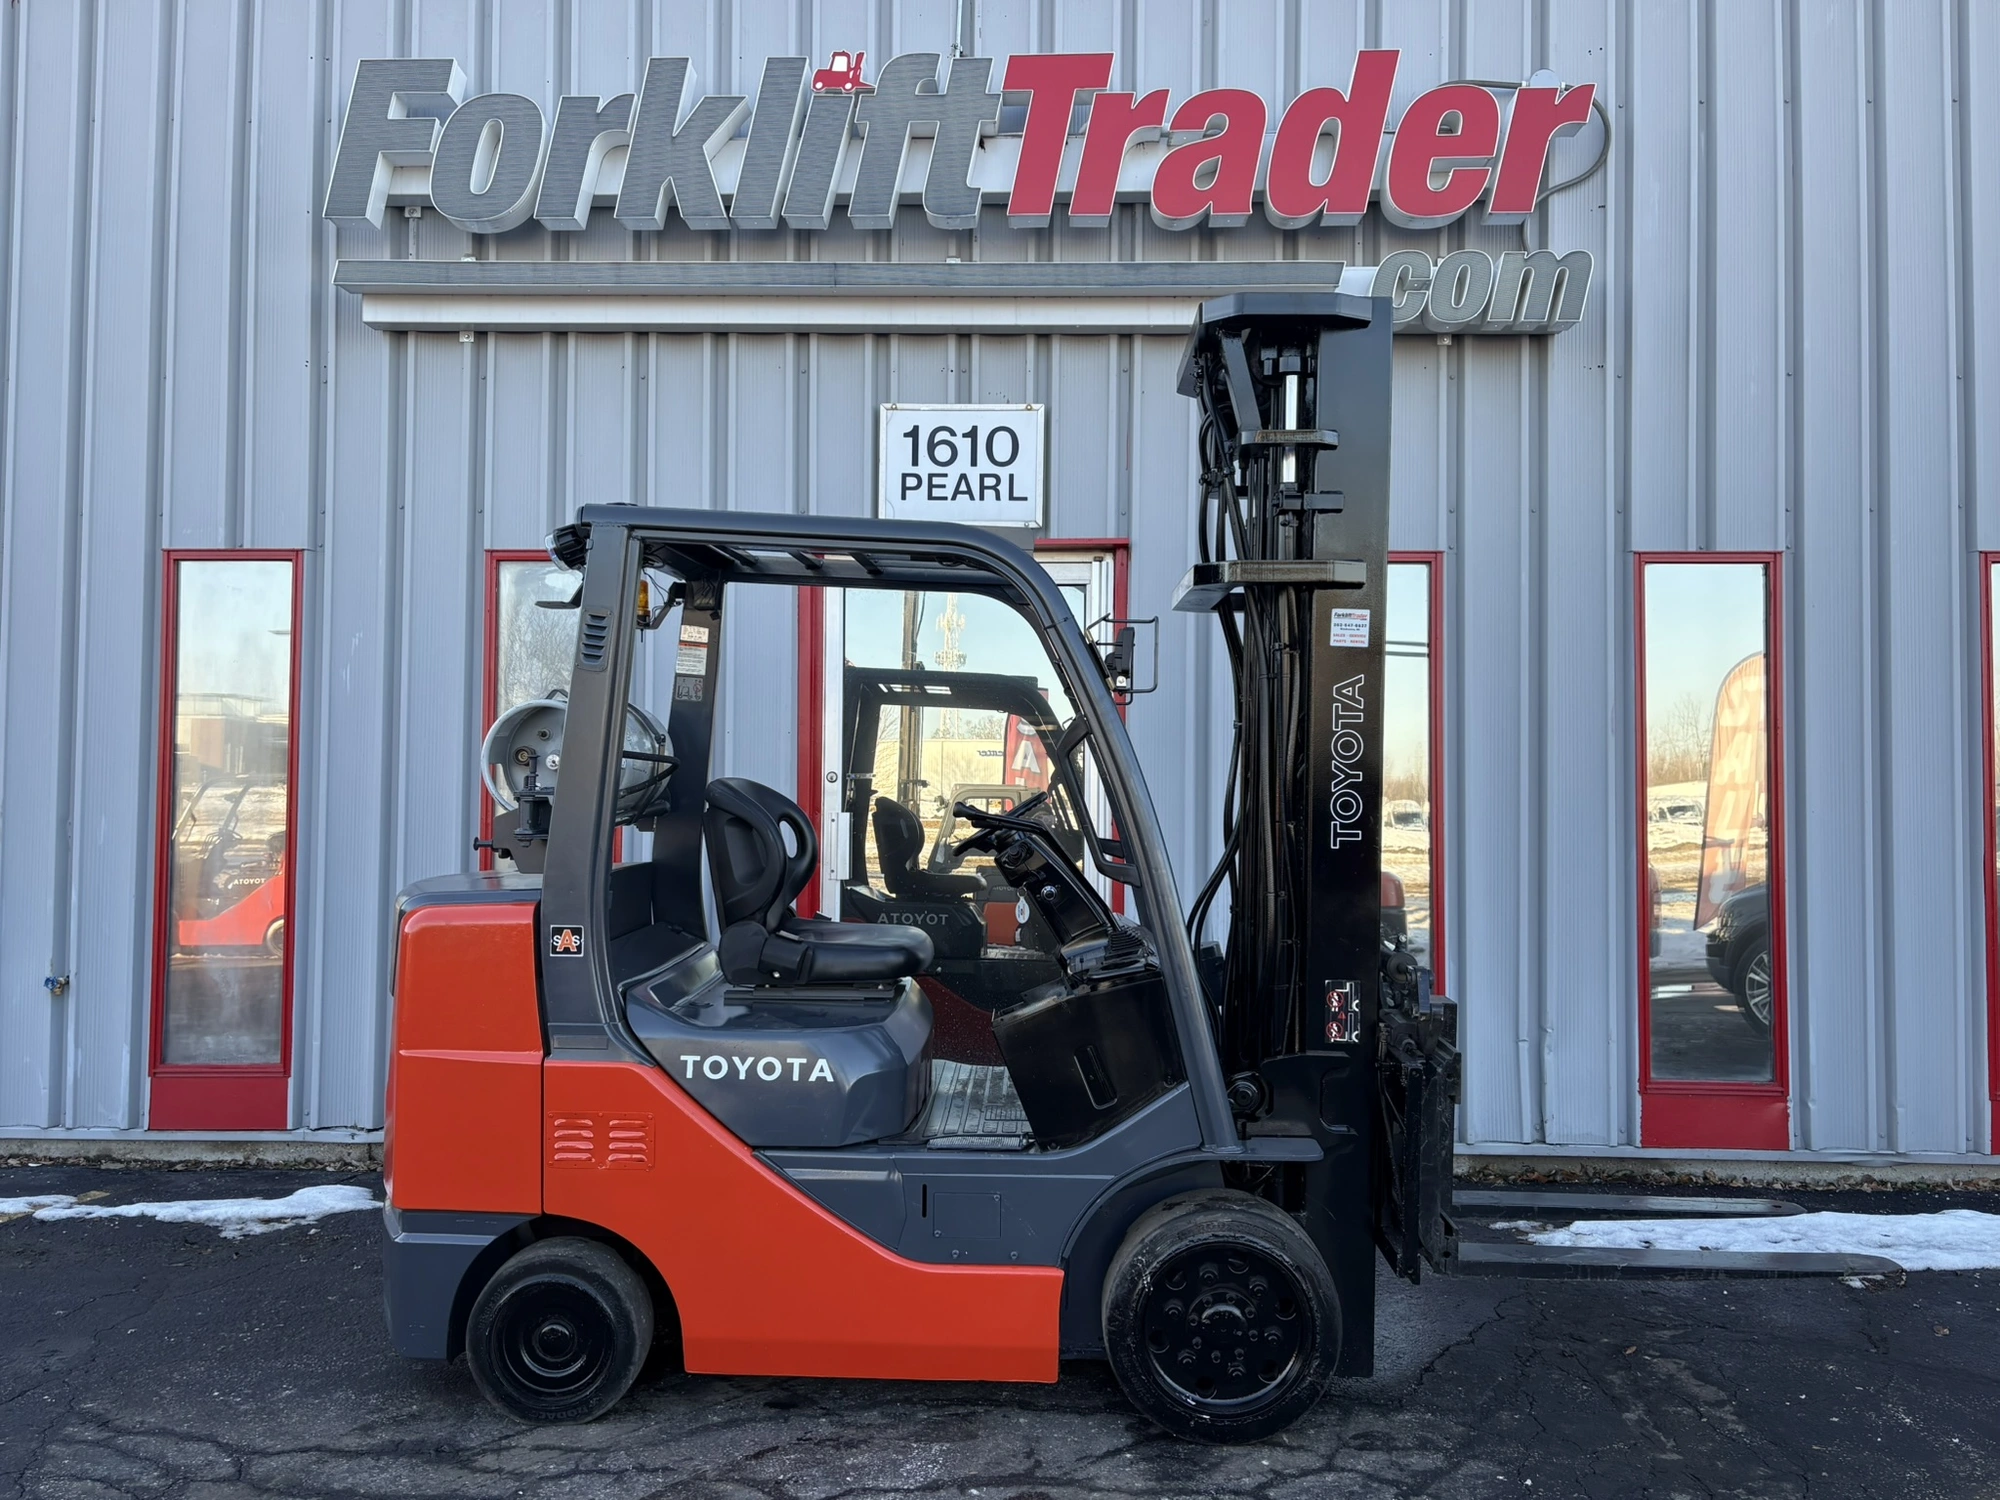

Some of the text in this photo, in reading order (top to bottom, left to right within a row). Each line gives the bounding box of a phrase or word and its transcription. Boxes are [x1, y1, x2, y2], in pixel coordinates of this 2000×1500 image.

[322, 48, 1596, 228] ForkliftTrader
[903, 425, 1019, 467] 1610
[901, 473, 1028, 501] PEARL
[1330, 673, 1365, 849] TOYOTA
[553, 929, 581, 952] SAS
[680, 1055, 834, 1083] TOYOTA
